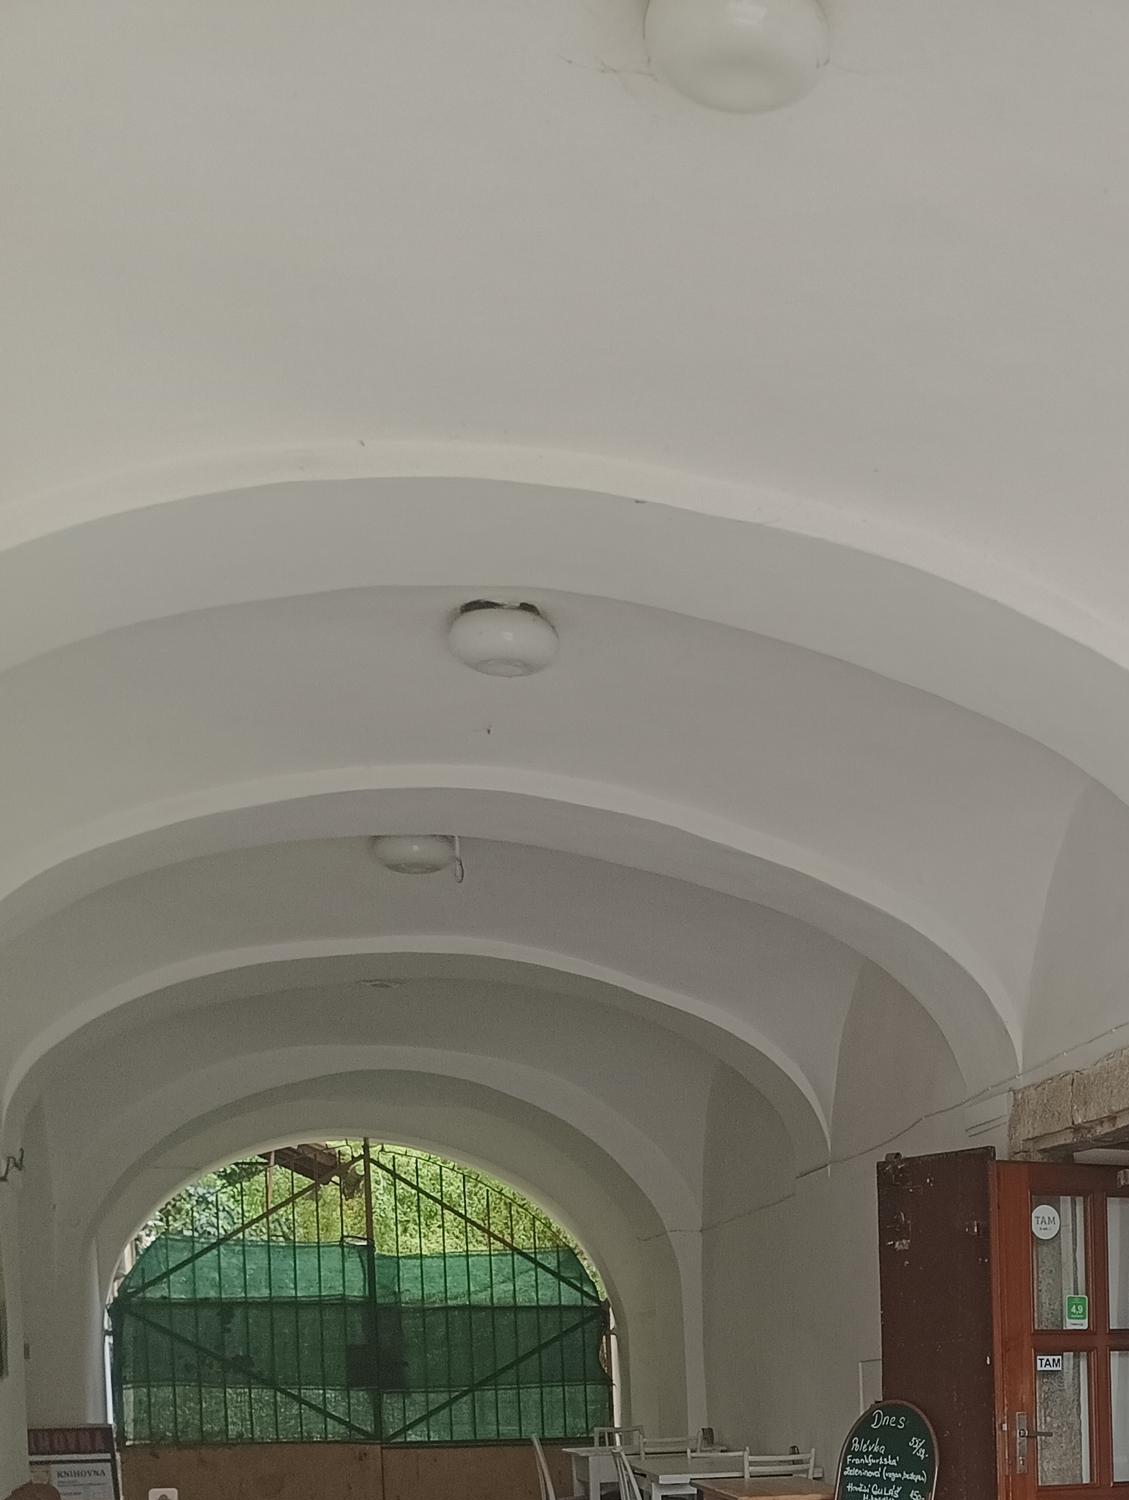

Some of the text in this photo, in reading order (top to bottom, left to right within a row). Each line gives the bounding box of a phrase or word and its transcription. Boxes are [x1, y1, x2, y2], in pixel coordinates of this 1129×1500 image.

[1034, 1215, 1056, 1225] TAM
[1070, 1304, 1084, 1314] 4,9
[1038, 1358, 1061, 1368] TAM
[870, 1409, 906, 1429] Dnes
[851, 1436, 886, 1455] Polévka
[846, 1454, 900, 1466] Frankfurtská
[56, 1469, 106, 1479] KNIHOVNA
